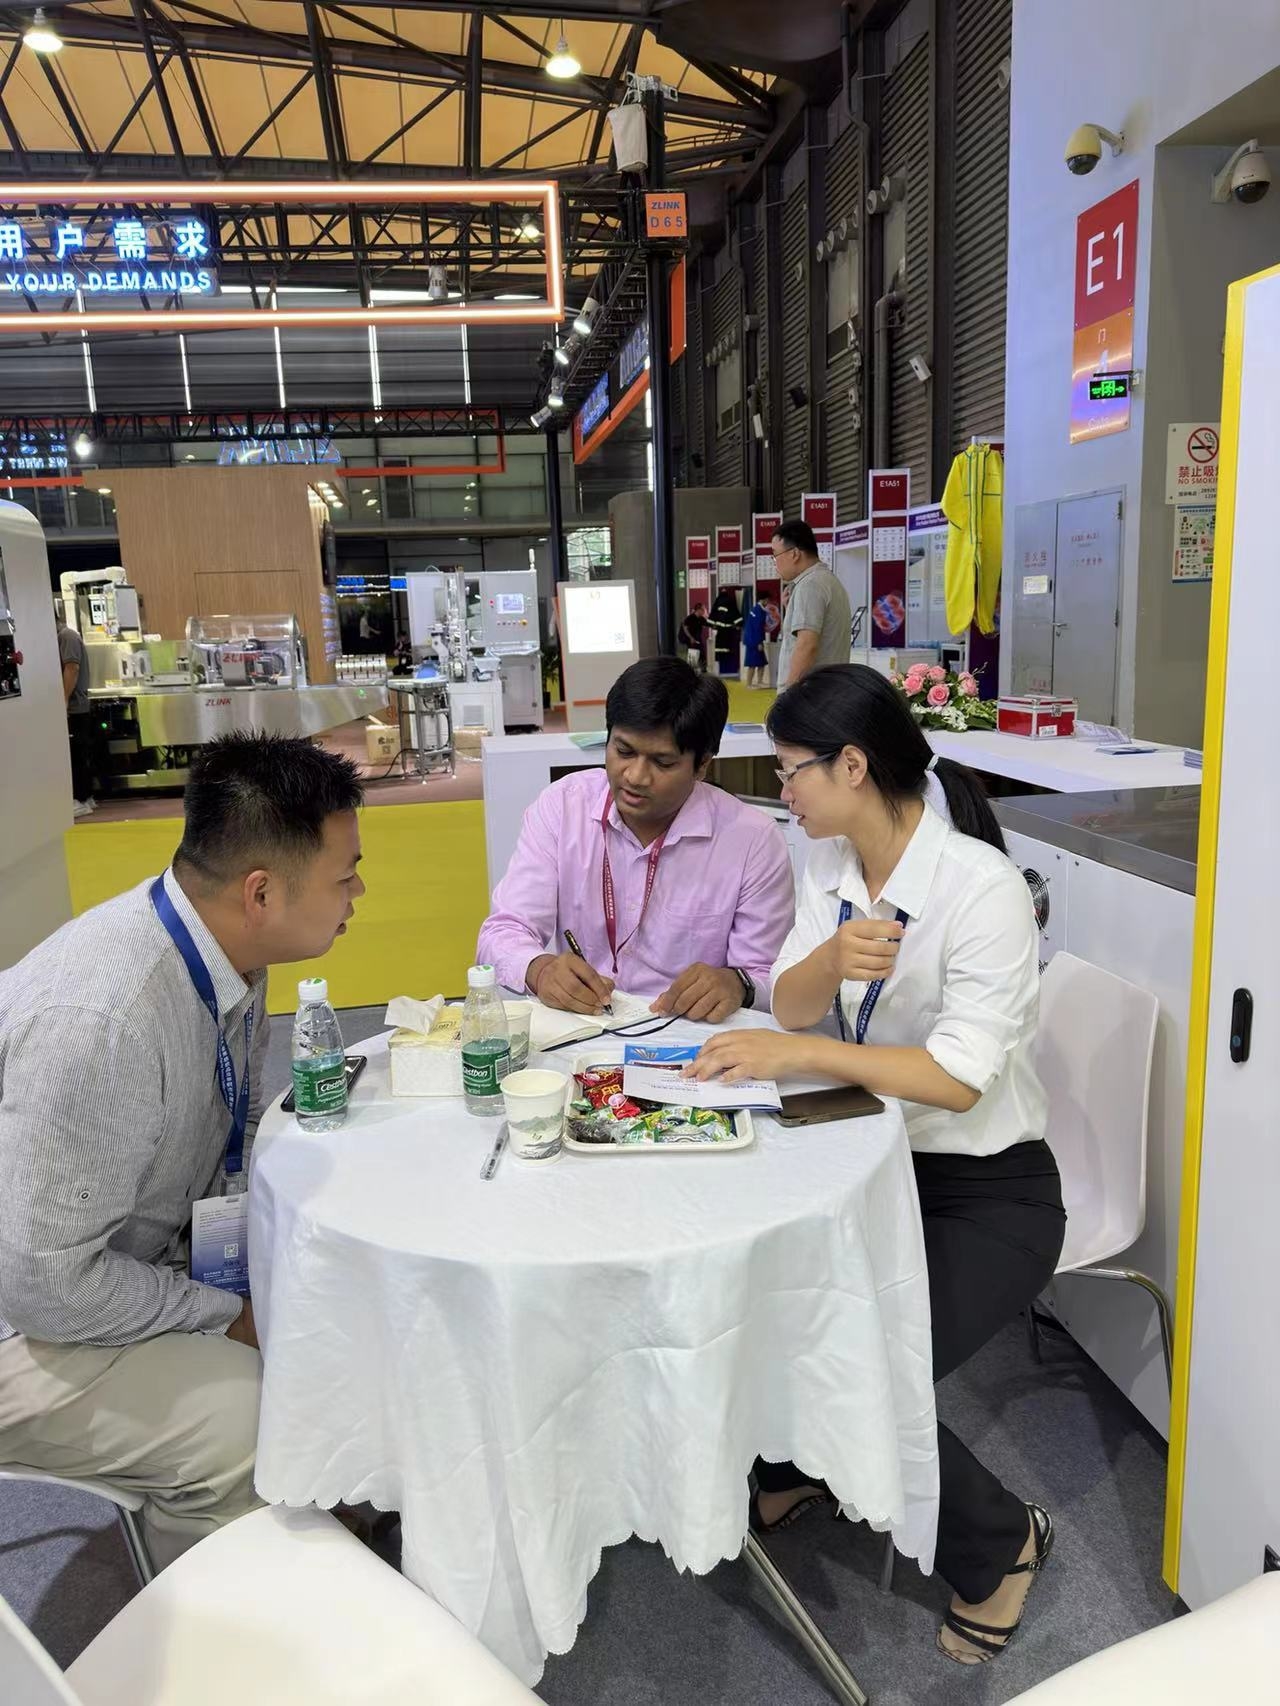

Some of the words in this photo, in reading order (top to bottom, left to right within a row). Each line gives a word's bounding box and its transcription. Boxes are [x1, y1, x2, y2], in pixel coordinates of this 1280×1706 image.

[651, 201, 680, 209] ZLINK
[0, 223, 208, 259] 用户需求
[1086, 222, 1124, 296] E1
[7, 273, 76, 291] YOUR
[88, 271, 211, 291] DEMANDS
[205, 698, 232, 707] ZLINK
